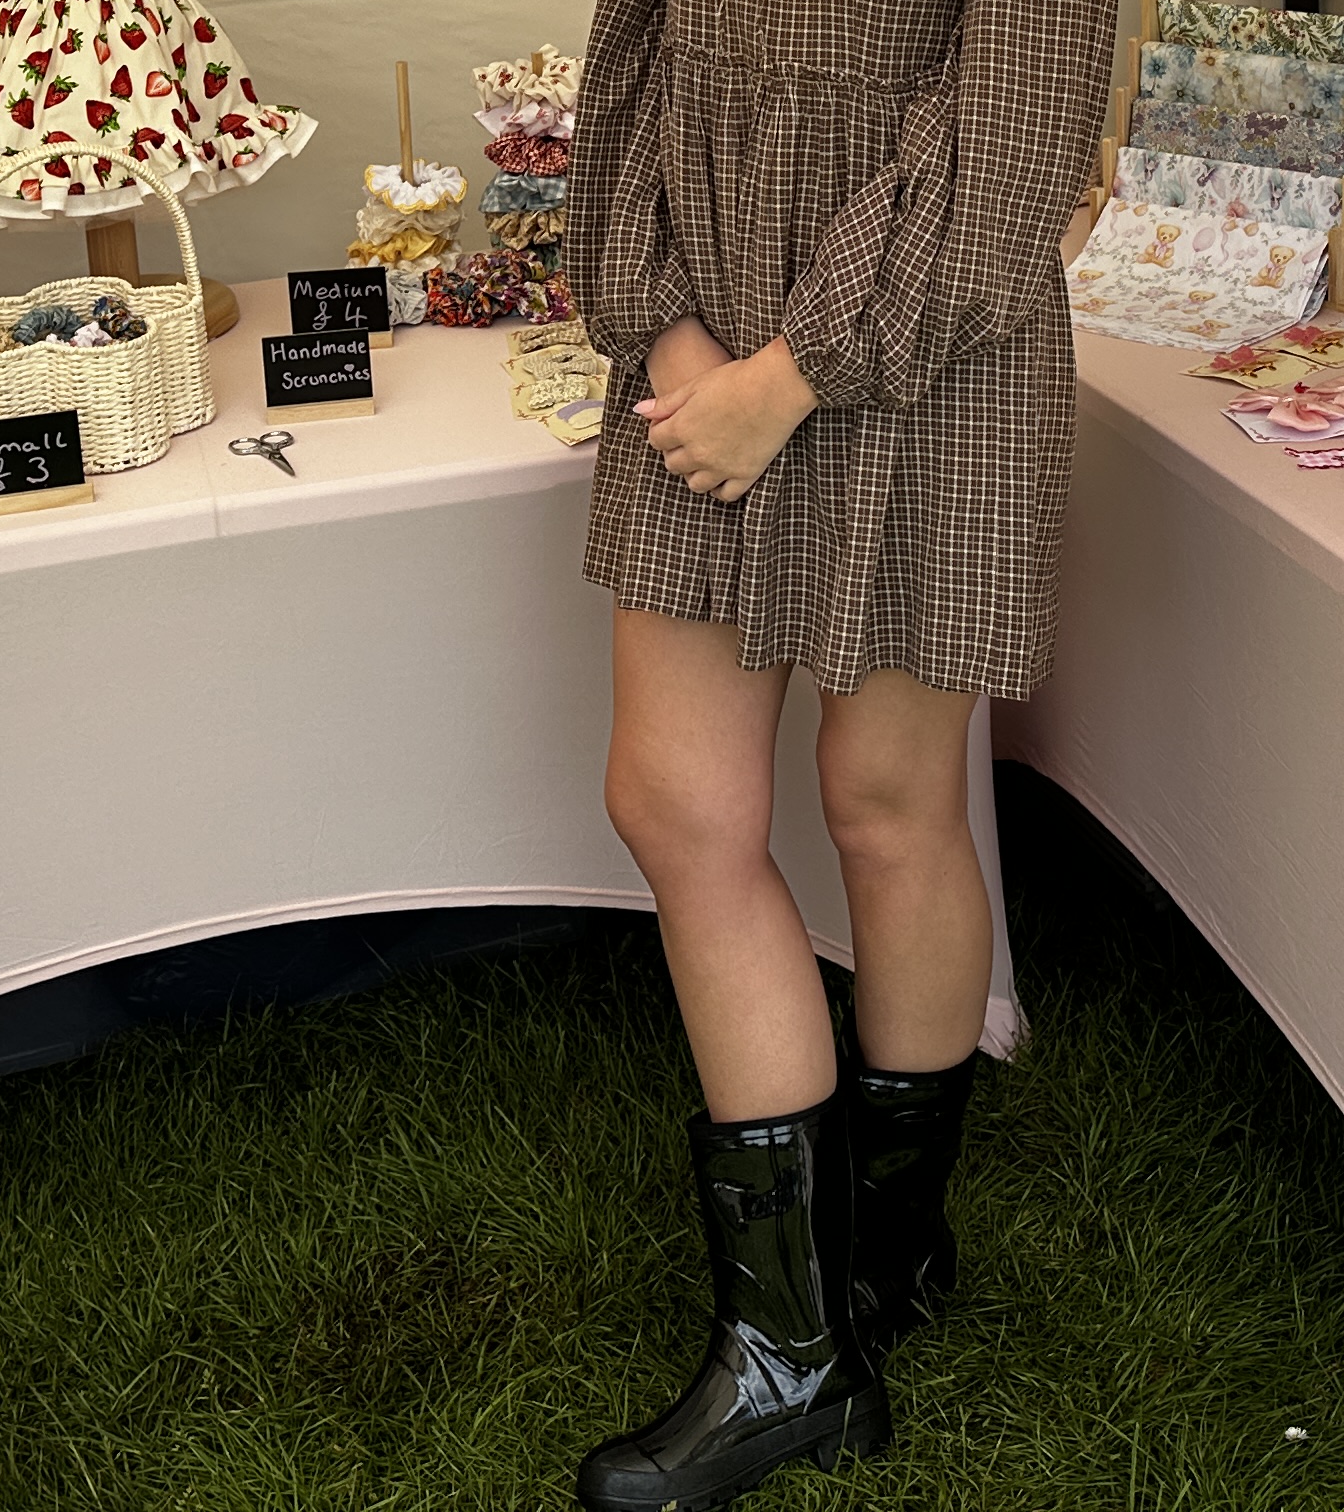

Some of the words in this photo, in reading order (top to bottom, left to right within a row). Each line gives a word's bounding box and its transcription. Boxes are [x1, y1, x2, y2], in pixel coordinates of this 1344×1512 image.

[293, 280, 383, 300] Medium
[270, 340, 367, 363] Handmade
[281, 363, 371, 390] Scrunchies
